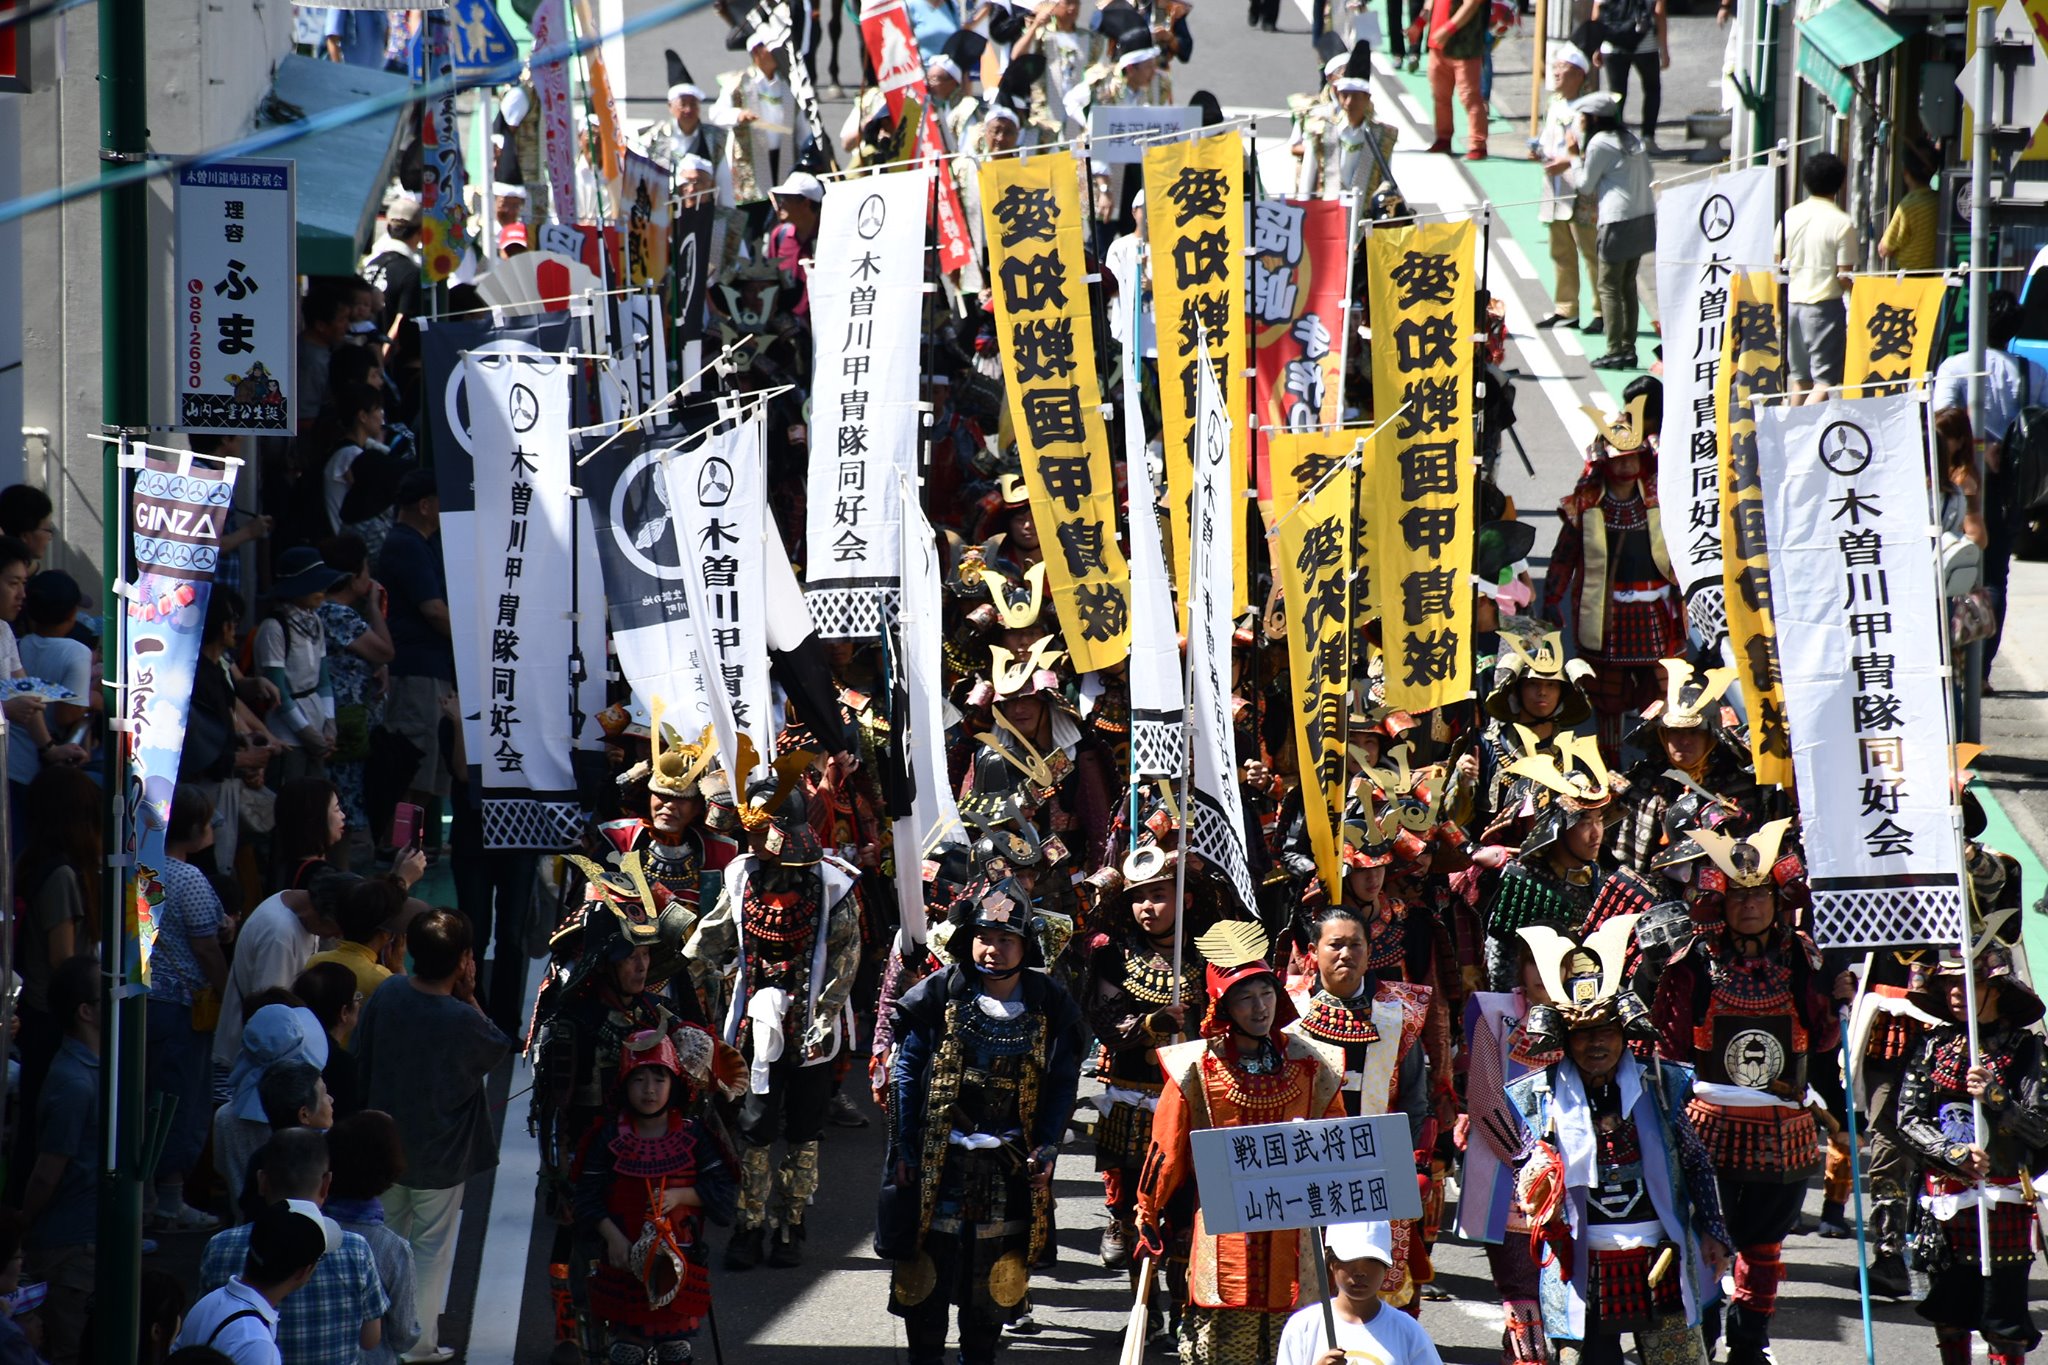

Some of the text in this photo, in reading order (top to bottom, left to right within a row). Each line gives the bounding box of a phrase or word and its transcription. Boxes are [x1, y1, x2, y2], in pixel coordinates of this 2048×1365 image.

[186, 170, 284, 188] 木曽川銀座街発展会
[224, 200, 245, 243] 理容
[213, 259, 259, 355] ふま
[188, 296, 202, 389] 86-2690
[833, 251, 882, 562] 木曽川甲冑隊同好会
[135, 502, 217, 538] GINZA
[489, 444, 541, 774] 木曽川甲冑隊同好会
[1829, 490, 1915, 859] 木曽川甲冑隊同好会
[1231, 1123, 1377, 1171] 戦国武将団
[1245, 1176, 1389, 1222] 山内一豊家臣団
